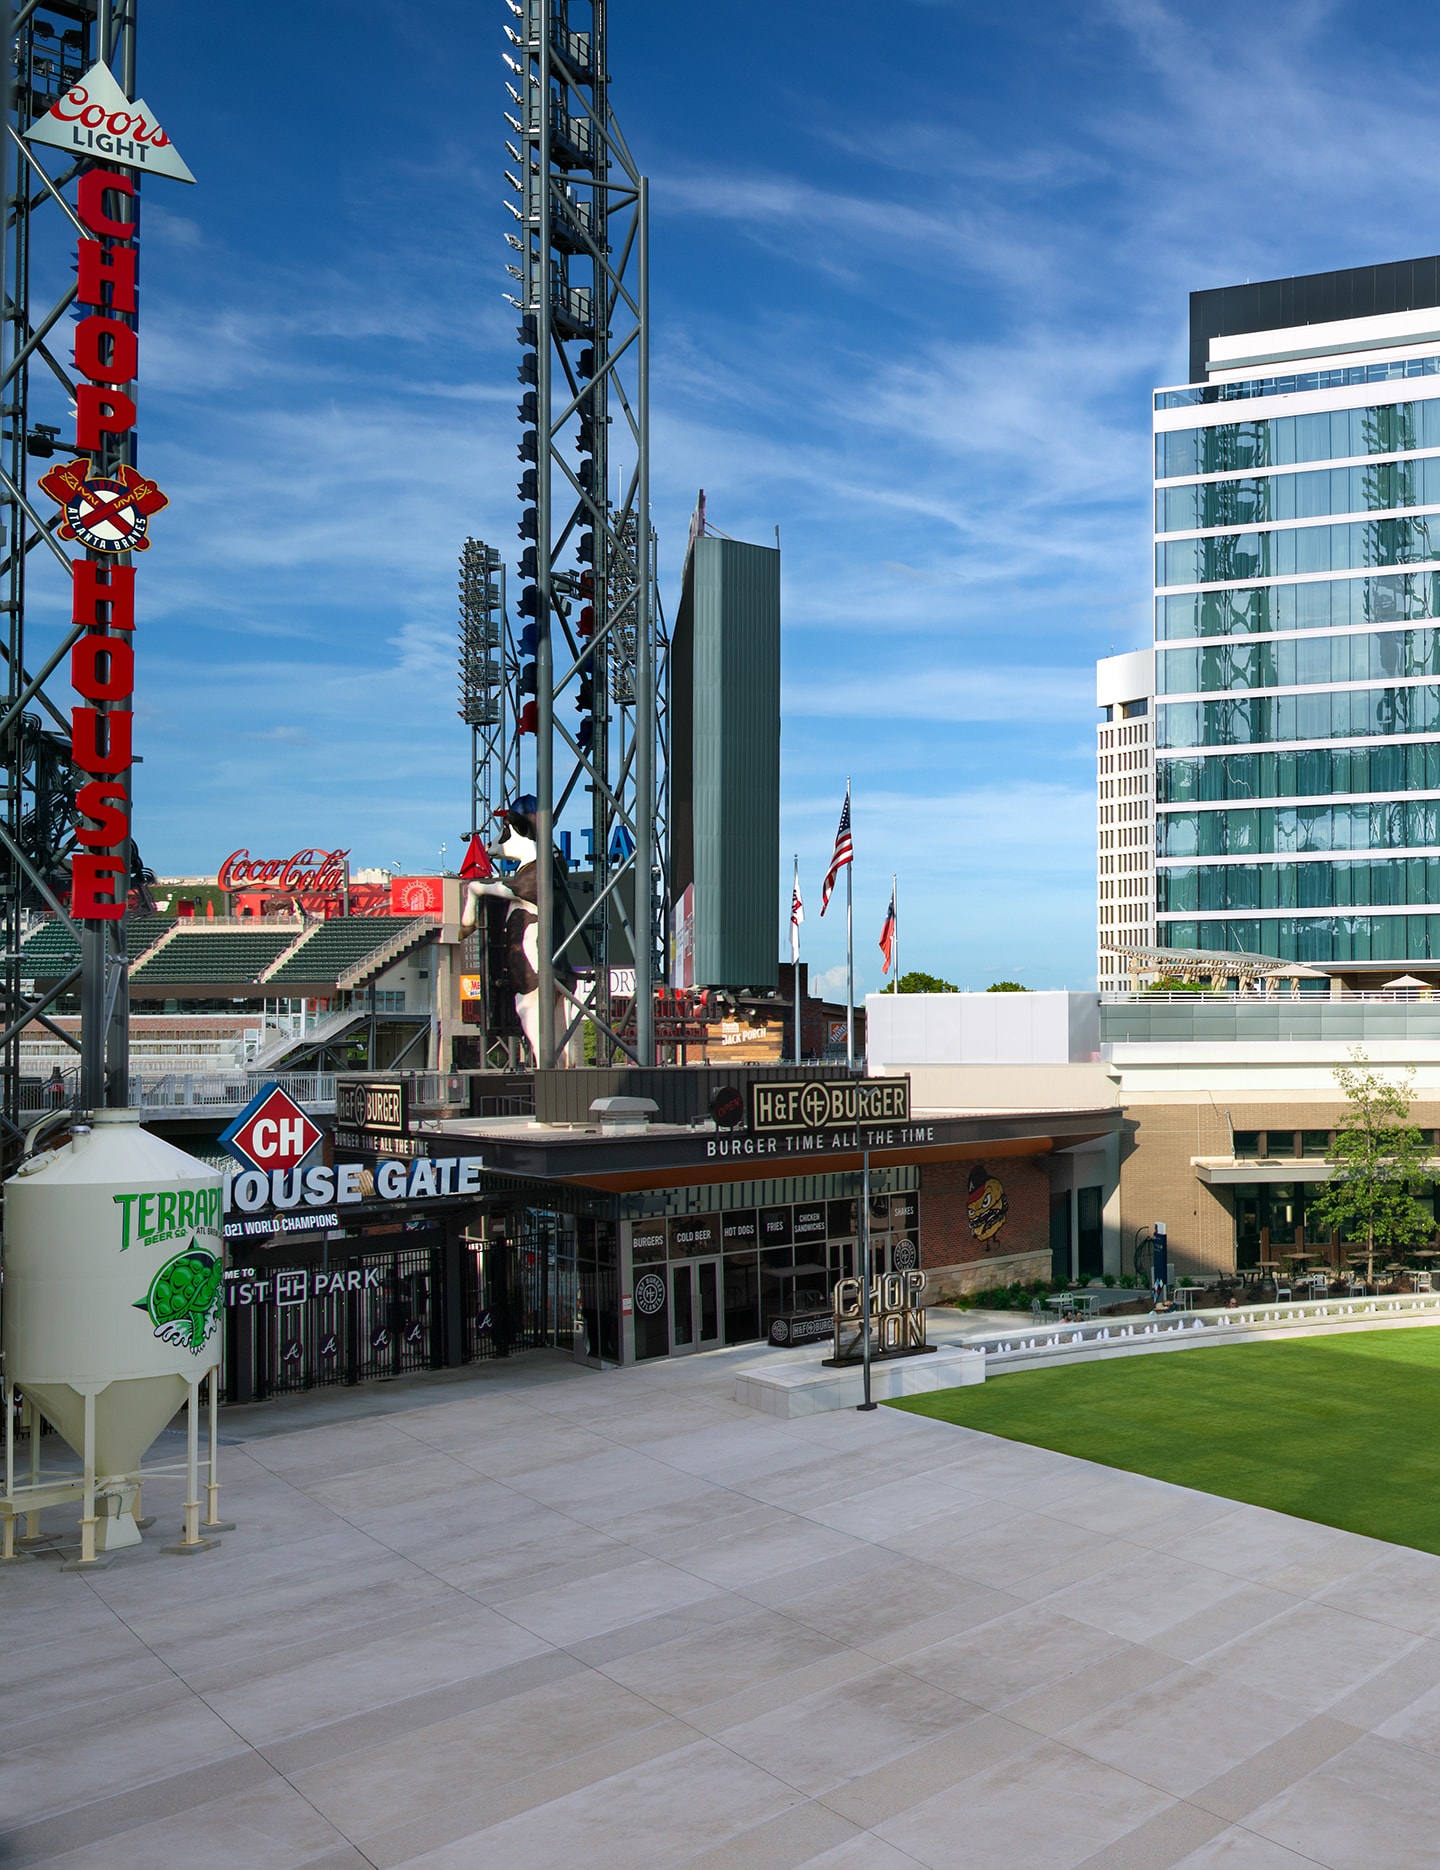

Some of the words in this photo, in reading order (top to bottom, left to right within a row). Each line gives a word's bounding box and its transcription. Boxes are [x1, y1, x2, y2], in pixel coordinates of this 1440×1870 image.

[50, 85, 172, 148] Coors
[72, 126, 150, 163] LIGHT
[75, 168, 138, 451] CHOP
[68, 507, 106, 550] ATLANTA
[113, 518, 147, 551] BRAVES
[70, 559, 138, 921] HOUSE
[217, 848, 352, 893] Coca-Cola
[367, 1092, 400, 1123] BURGER
[759, 1091, 799, 1122] H&F
[831, 1087, 904, 1119] BURGER
[252, 1118, 304, 1158] CH
[380, 1137, 394, 1153] ALL
[394, 1138, 409, 1154] THE
[707, 1137, 777, 1157] BURGER
[786, 1134, 825, 1152] TIME
[832, 1131, 858, 1148] ALL
[867, 1129, 894, 1145] THE
[901, 1126, 934, 1143] TIME
[374, 1156, 483, 1200] GATE
[113, 1186, 223, 1252] TERRAPI
[223, 1222, 243, 1237] 021
[244, 1219, 280, 1235] WORLD
[281, 1213, 339, 1231] CHAMPIONS
[766, 1220, 784, 1232] FRIES
[799, 1212, 821, 1223] CHICKEN
[893, 1206, 915, 1217] SHAKES
[144, 1231, 173, 1247] BEER
[196, 1226, 206, 1236] ATL
[633, 1235, 664, 1248] BURGERS
[676, 1231, 694, 1243] COLD
[695, 1229, 712, 1241] BEER
[724, 1226, 737, 1238] HOT
[738, 1224, 755, 1236] DOGS
[794, 1221, 826, 1233] SANDWICHES
[224, 1270, 240, 1280] ME
[241, 1268, 255, 1279] TO
[314, 1267, 379, 1296] PARK
[640, 1298, 661, 1311] ATLANTA
[834, 1269, 927, 1318] CHOP
[879, 1308, 927, 1351] ON
